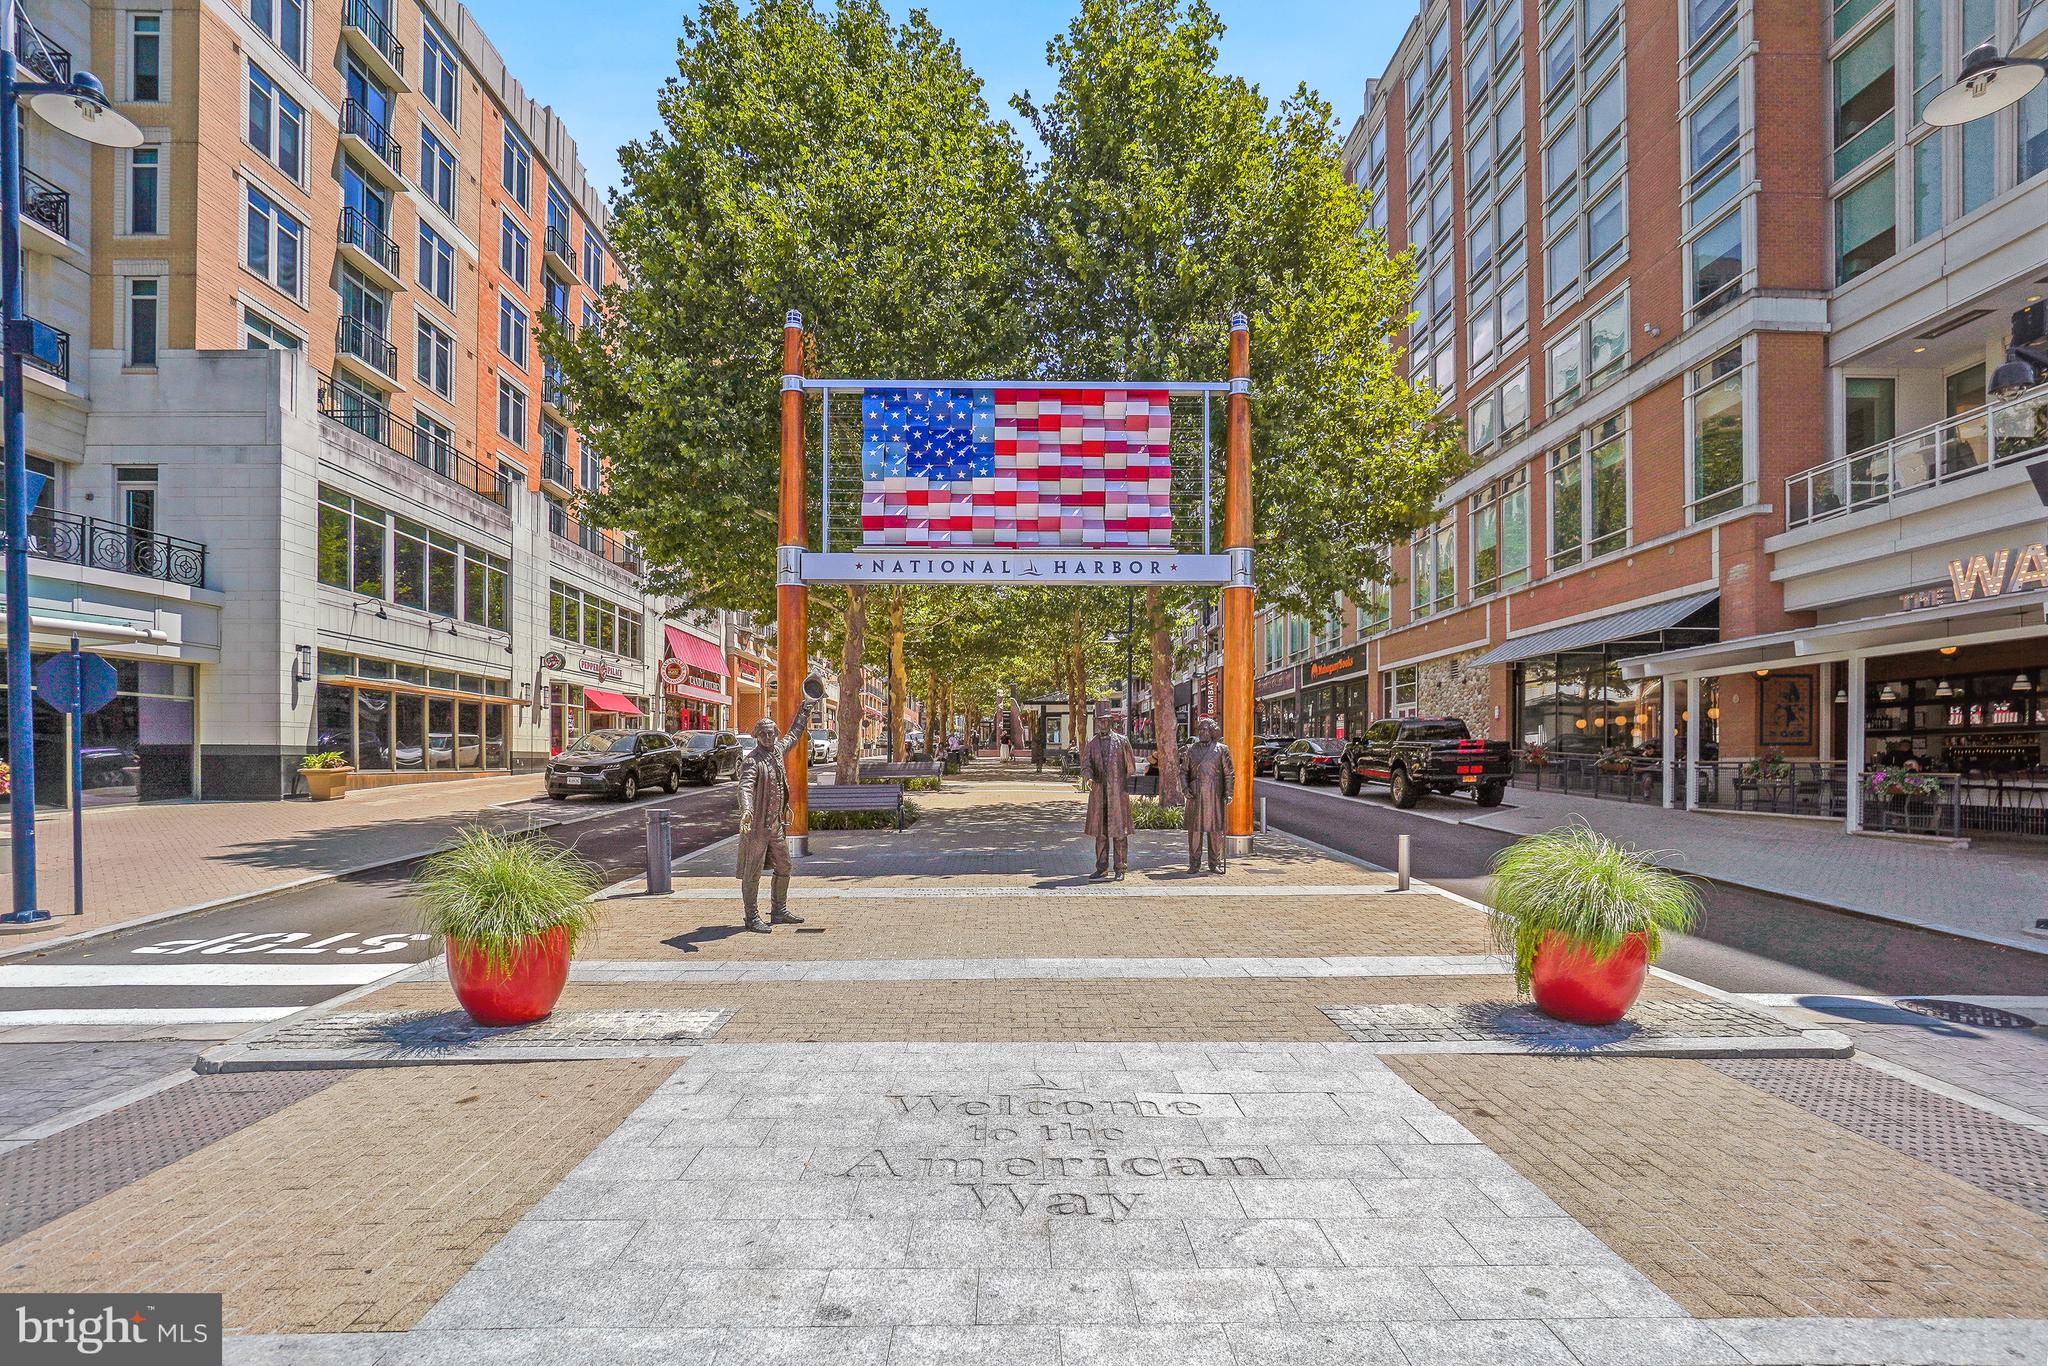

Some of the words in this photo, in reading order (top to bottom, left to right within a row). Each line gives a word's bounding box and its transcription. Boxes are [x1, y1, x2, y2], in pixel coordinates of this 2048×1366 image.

[872, 559, 1011, 575] NATIONAL
[1054, 560, 1161, 575] HARBOR
[1899, 587, 1945, 611] THE
[581, 660, 599, 672] PEPPER
[607, 666, 622, 677] PALACE
[885, 1094, 1203, 1116] Welcome
[968, 1122, 1018, 1141] to
[1040, 1122, 1126, 1141] the
[829, 1149, 1271, 1178] American
[952, 1182, 1146, 1224] Way
